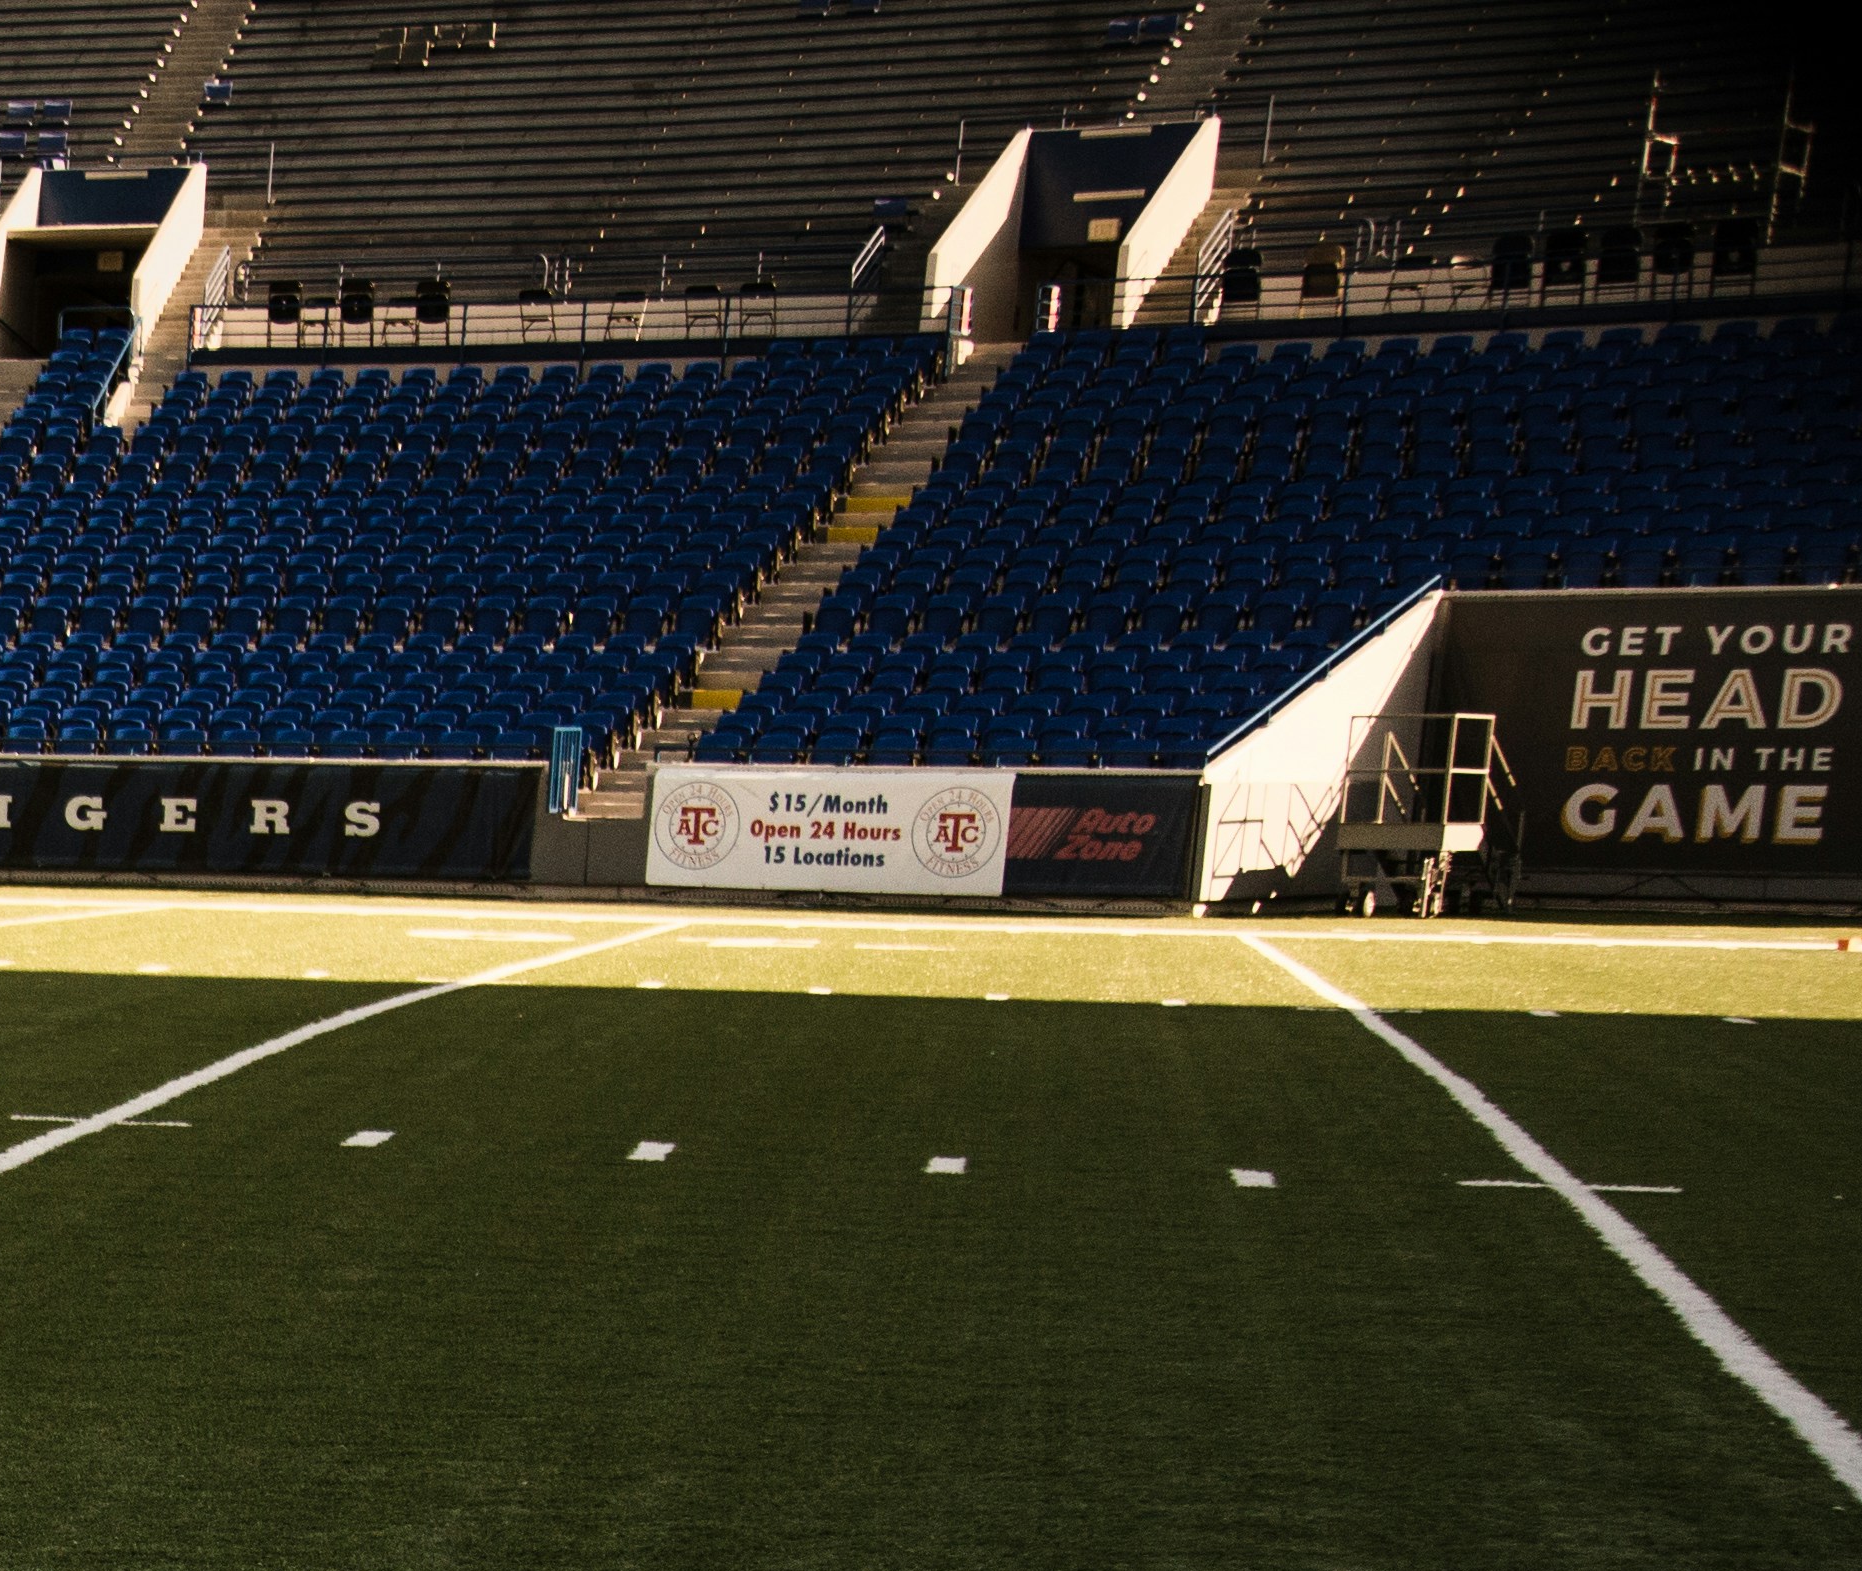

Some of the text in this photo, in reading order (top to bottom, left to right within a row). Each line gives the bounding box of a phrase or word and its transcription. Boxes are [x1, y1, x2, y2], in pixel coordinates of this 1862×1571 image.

[1581, 624, 1853, 657] GET YOUR
[1570, 668, 1843, 731] HEAD
[1565, 746, 1835, 773] BACK IN THE
[1070, 807, 1157, 835] Auto
[1560, 783, 1830, 845] GAME
[750, 819, 901, 843] Open 24 Hours
[764, 845, 885, 867] 15 Locations
[1053, 834, 1143, 861] Zone
